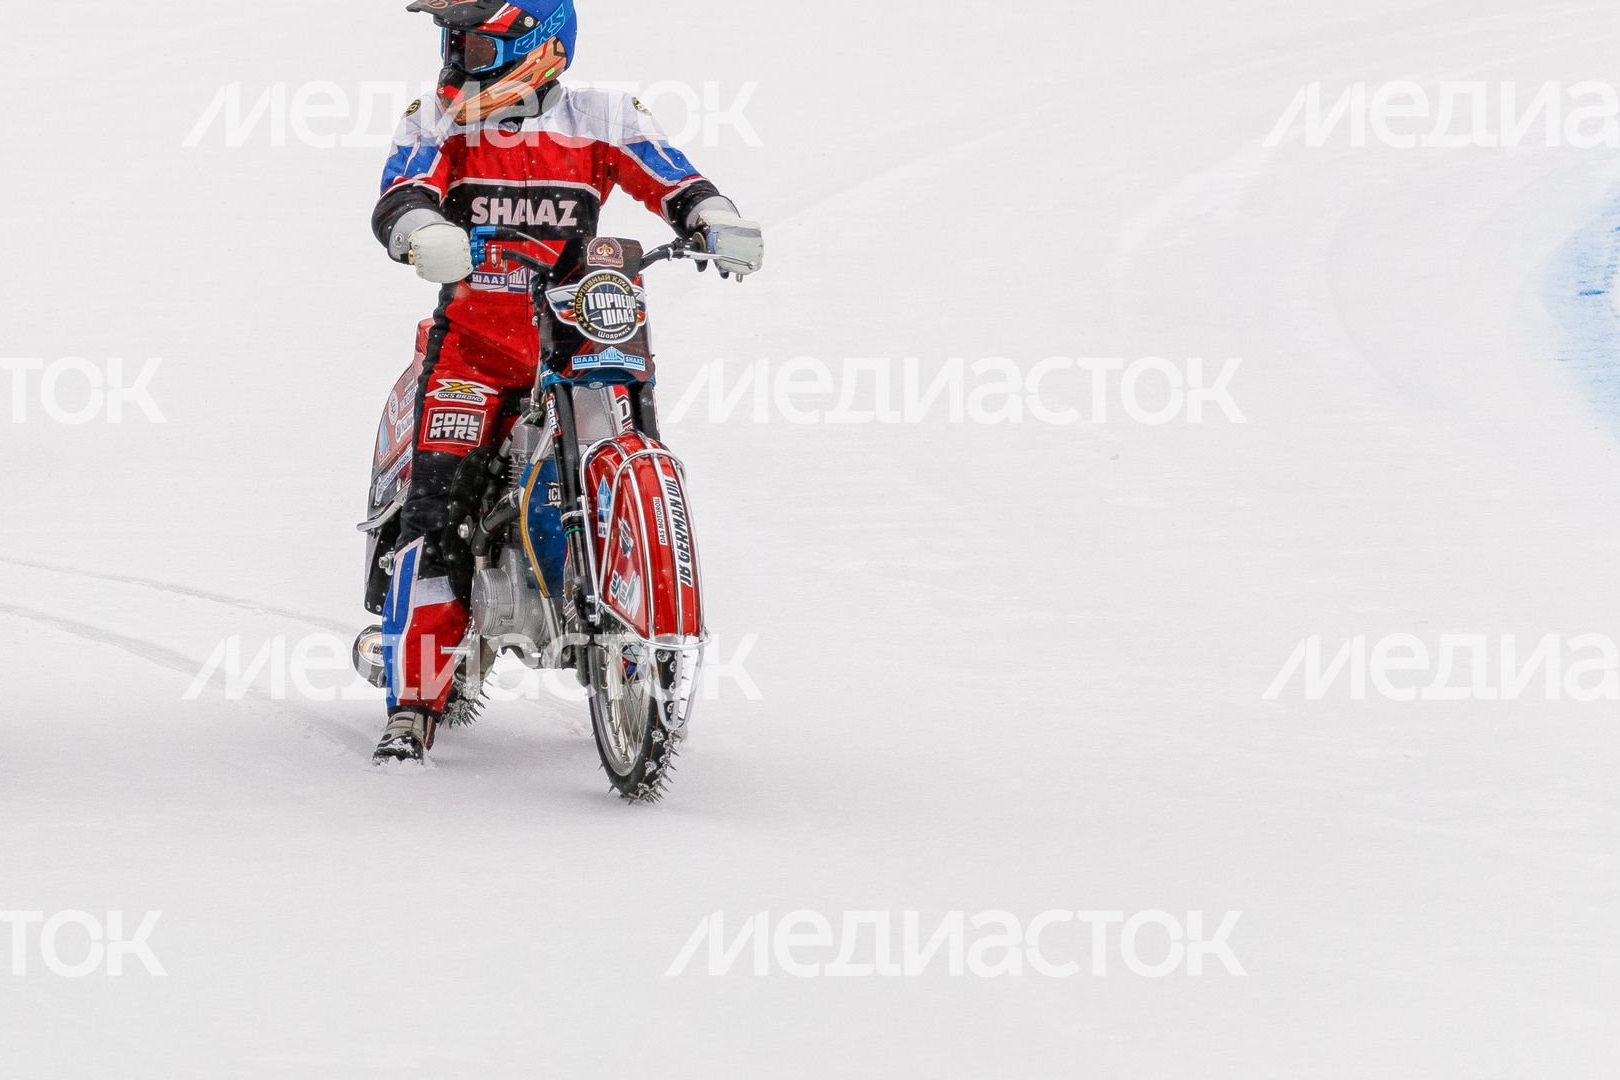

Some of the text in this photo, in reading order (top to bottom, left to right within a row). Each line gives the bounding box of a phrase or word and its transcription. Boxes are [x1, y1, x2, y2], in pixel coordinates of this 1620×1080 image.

[471, 196, 578, 227] SHAAZ
[472, 274, 506, 285] ШААЗ
[576, 274, 611, 314] СПОРТИВНЫЙ
[585, 292, 637, 310] ТОРПЕДО
[431, 412, 480, 427] COOL
[429, 426, 479, 441] MTRS
[655, 497, 667, 545] DAS MOTOROIL
[671, 503, 692, 565] GERMAN
